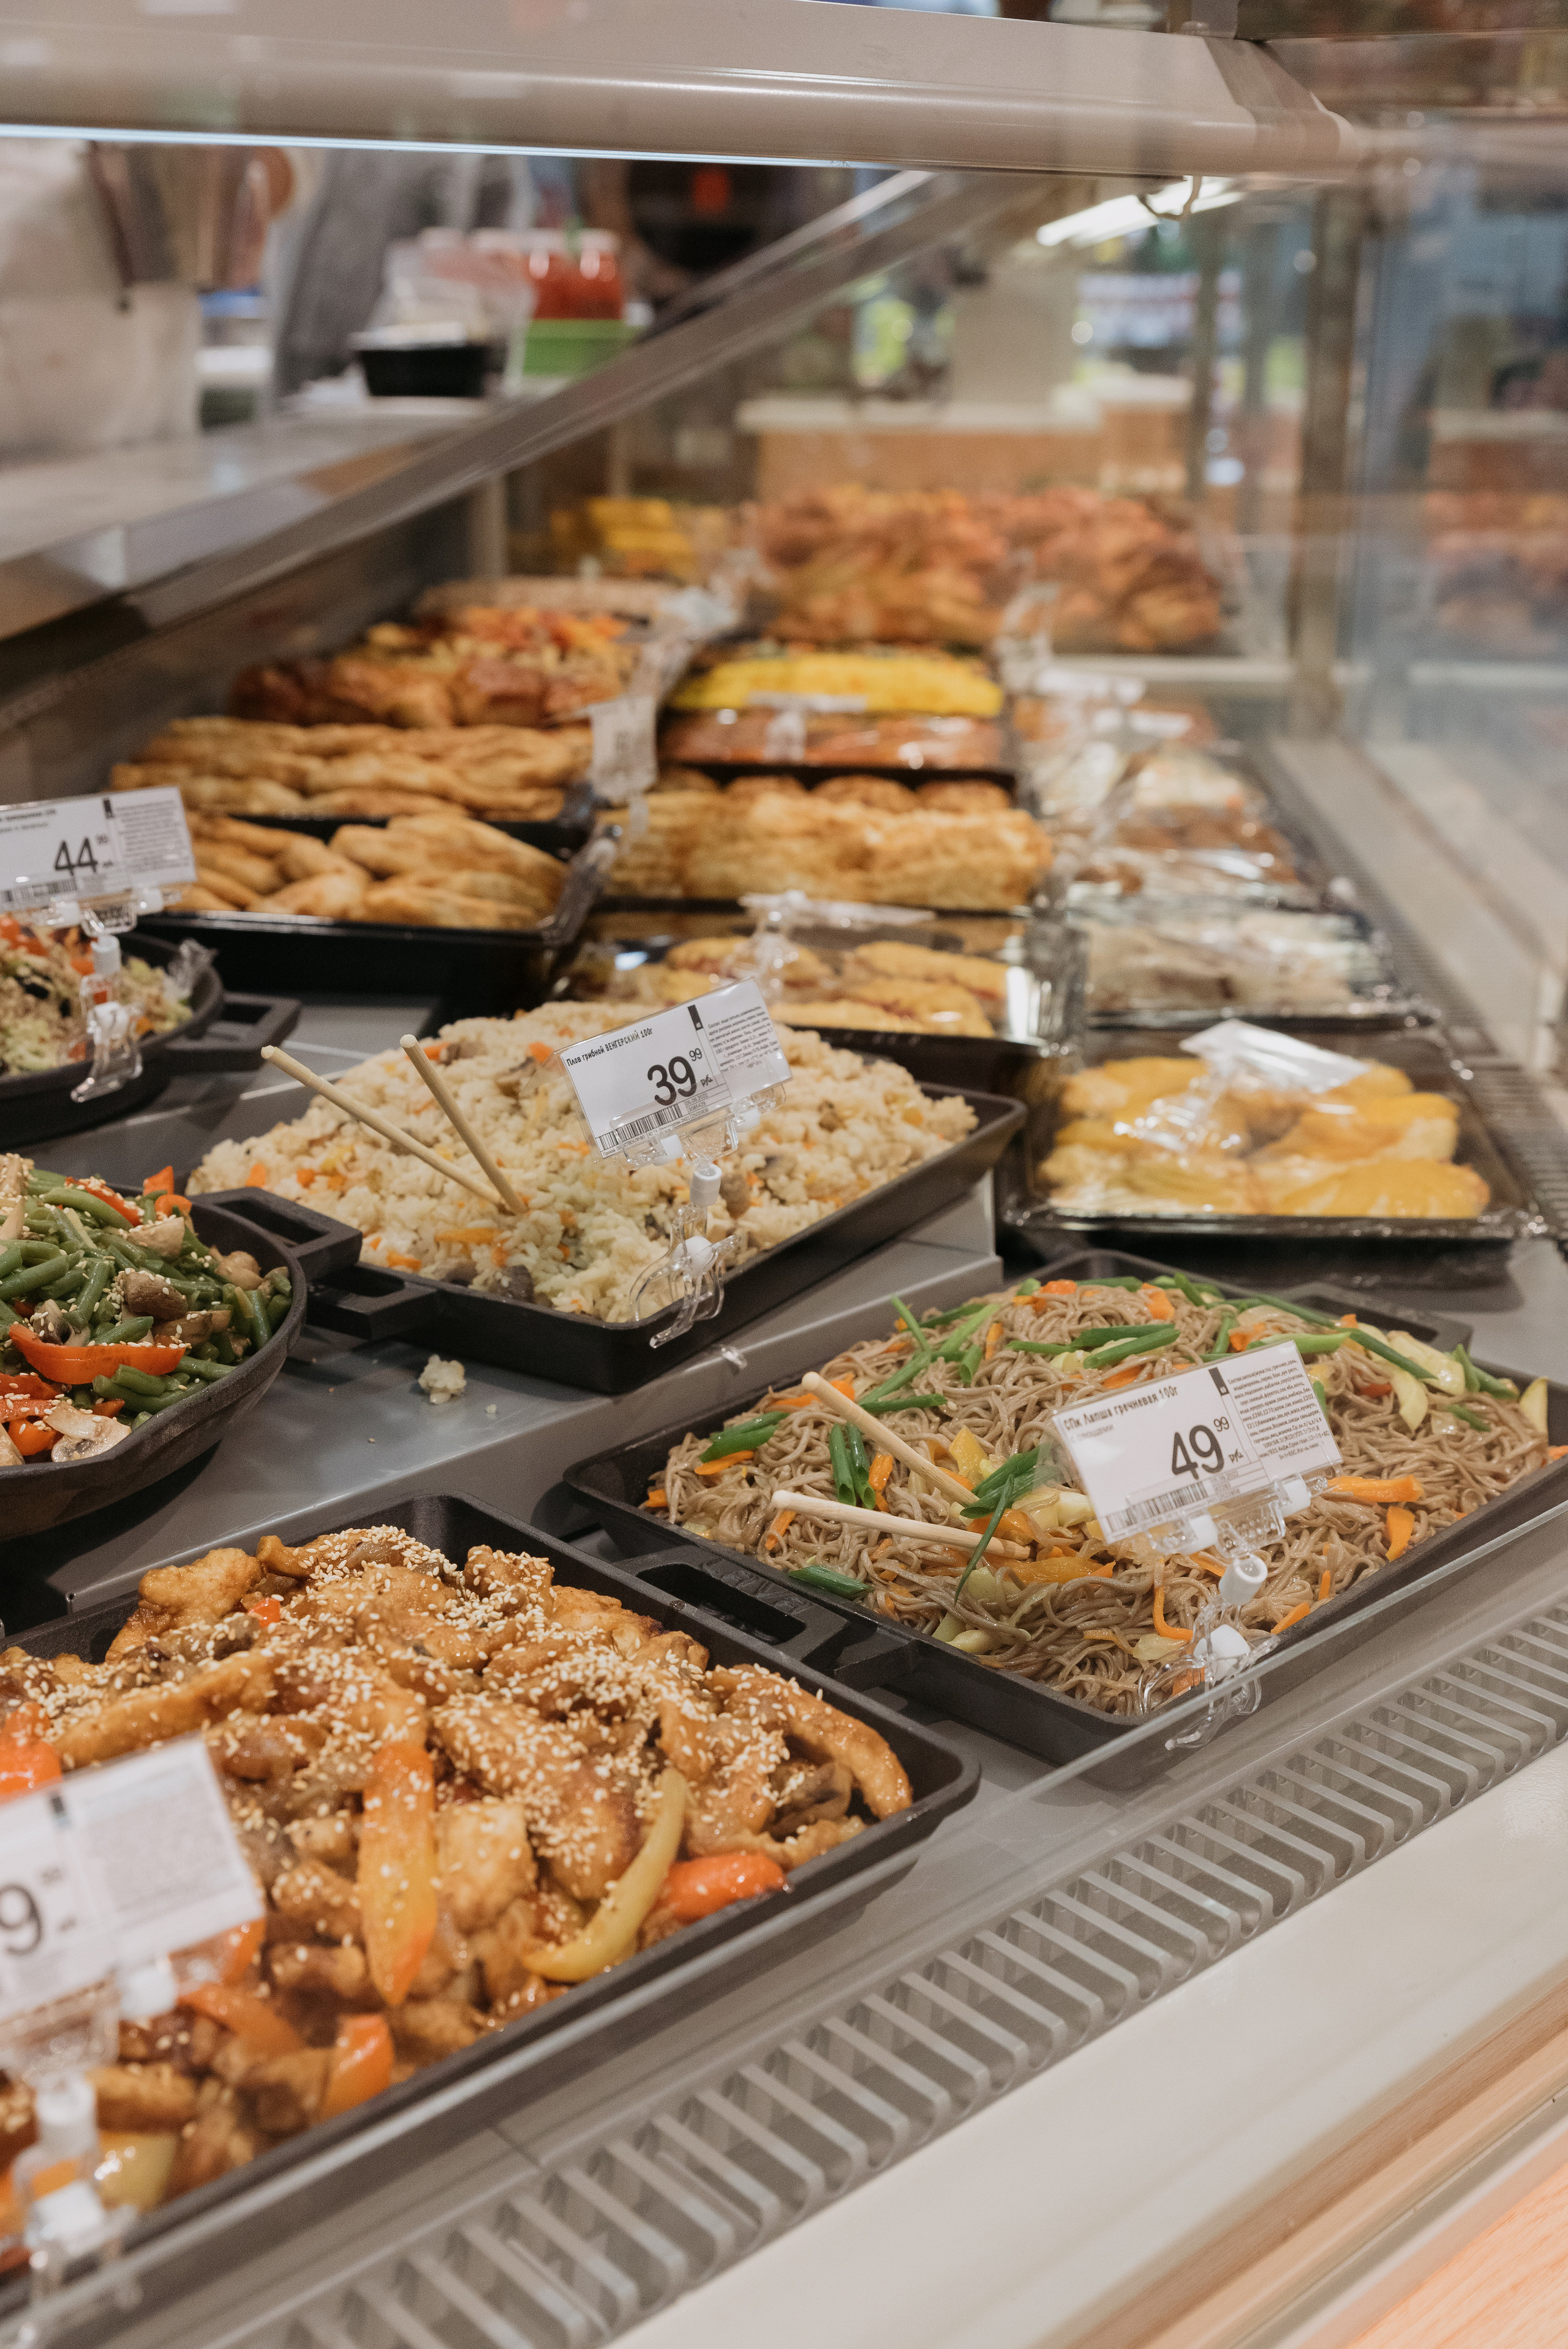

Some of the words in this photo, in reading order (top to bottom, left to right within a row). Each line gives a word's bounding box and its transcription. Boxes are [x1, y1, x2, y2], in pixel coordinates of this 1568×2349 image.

[54, 837, 98, 876] 44
[582, 1046, 605, 1062] грибной
[605, 1030, 640, 1052] ВЕНГЕРСКИЙ
[640, 1027, 653, 1038] 100г
[647, 1056, 697, 1106] 39
[689, 1048, 703, 1061] 99
[1084, 1407, 1112, 1424] Лапша
[1114, 1393, 1158, 1417] гречневая
[1159, 1385, 1178, 1400] 100г
[1172, 1424, 1224, 1480] 49
[1213, 1417, 1229, 1432] 99
[0, 1881, 44, 1956] 9
